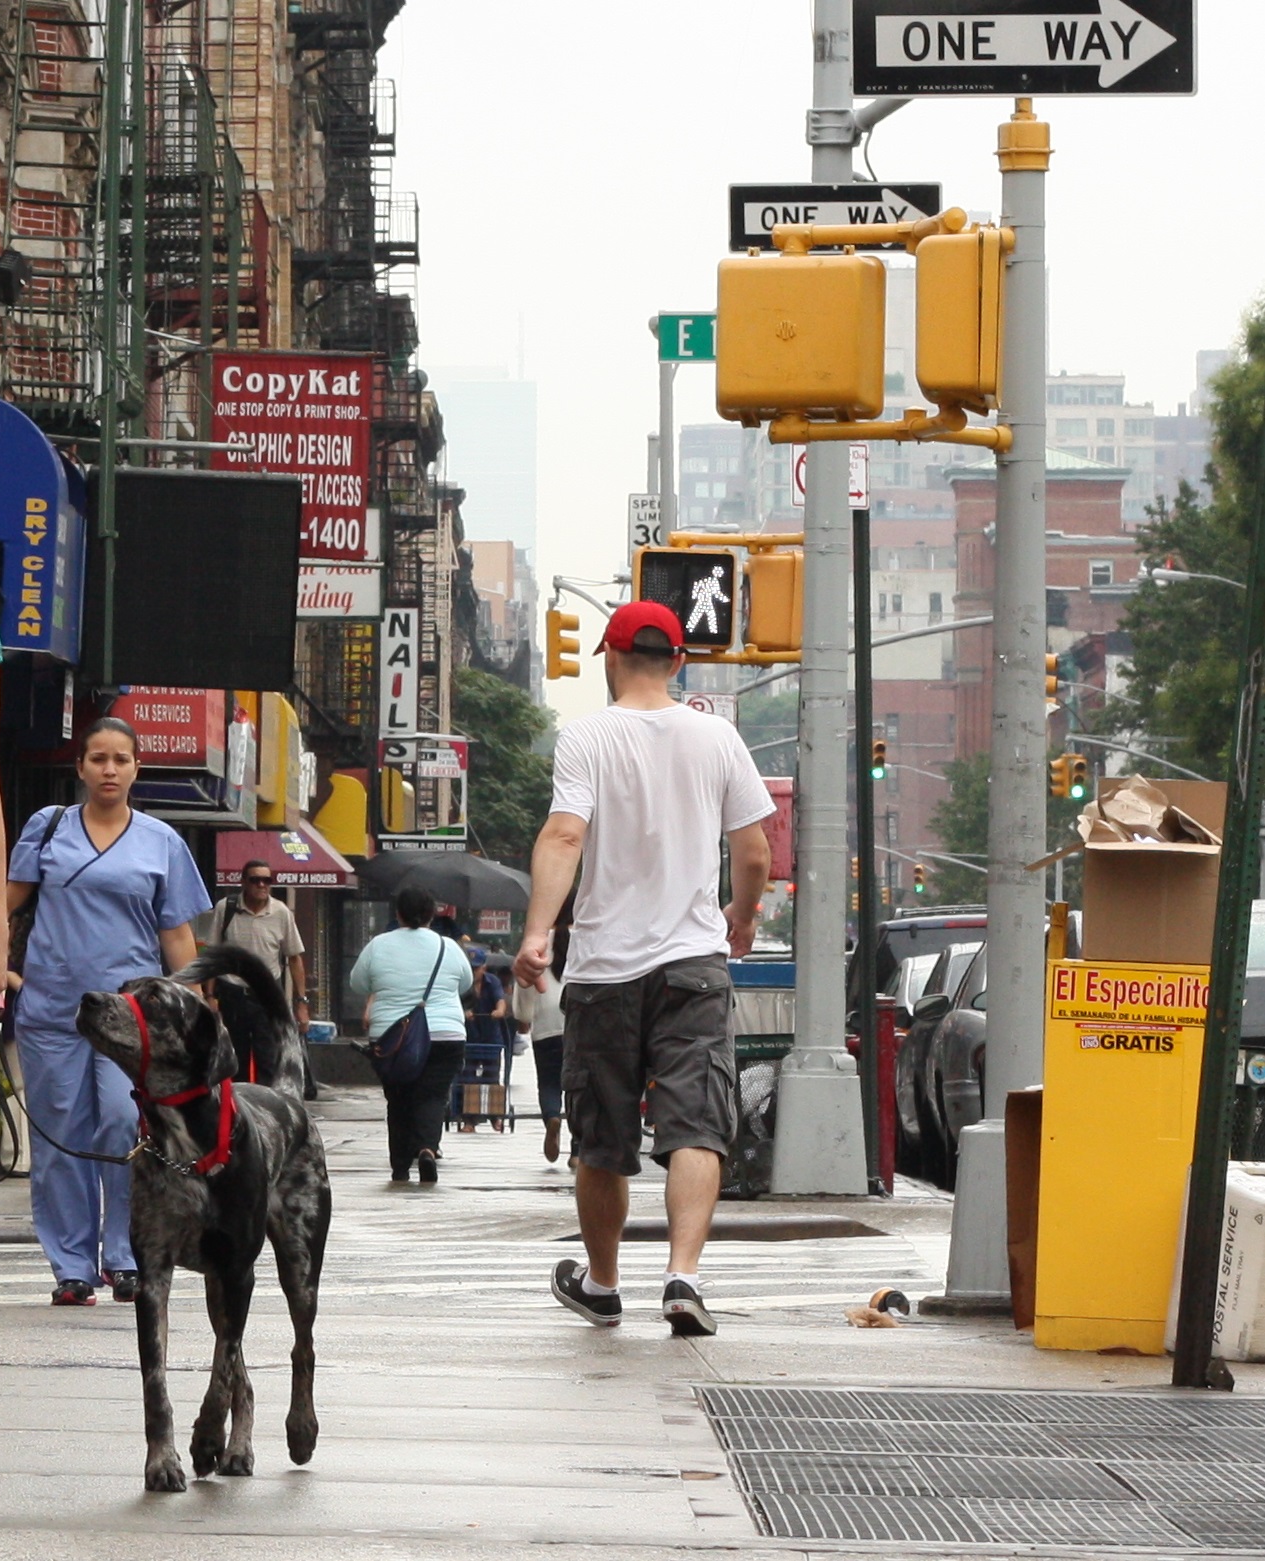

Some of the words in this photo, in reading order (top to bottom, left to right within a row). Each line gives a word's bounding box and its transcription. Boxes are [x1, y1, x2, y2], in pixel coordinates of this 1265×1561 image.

[902, 21, 997, 61] ONE
[1043, 21, 1142, 61] WAY
[761, 206, 818, 230] ONE
[847, 206, 908, 224] WAY
[678, 319, 693, 356] E
[222, 366, 361, 401] CopyKat
[239, 403, 263, 417] STOP
[267, 404, 292, 418] COPY
[295, 404, 301, 418] &
[304, 405, 332, 419] PRINT
[227, 431, 292, 465] GRAPHIC
[298, 434, 352, 466] DESIGN
[316, 473, 362, 506] ACCESS
[632, 500, 661, 509] SPE
[23, 498, 48, 545] DRY
[18, 556, 45, 635] CLEAN
[134, 704, 150, 722] FAX
[152, 704, 192, 723] SERVICES
[136, 734, 168, 753] SINESS
[170, 734, 198, 754] CARDS
[276, 873, 297, 883] OPEN
[299, 873, 309, 883] 24
[310, 873, 337, 884] HOURS
[1056, 969, 1076, 1000] El
[1058, 1009, 1067, 1017] EL
[1070, 1010, 1116, 1020] SEMANARIO
[1118, 1013, 1129, 1021] DE
[1144, 1015, 1175, 1023] FAMILIA
[1177, 1016, 1205, 1025] HISPAN
[1100, 1034, 1174, 1052] GRATIS
[1212, 1281, 1229, 1344] POSTAL
[1222, 1205, 1238, 1276] SERVICE
